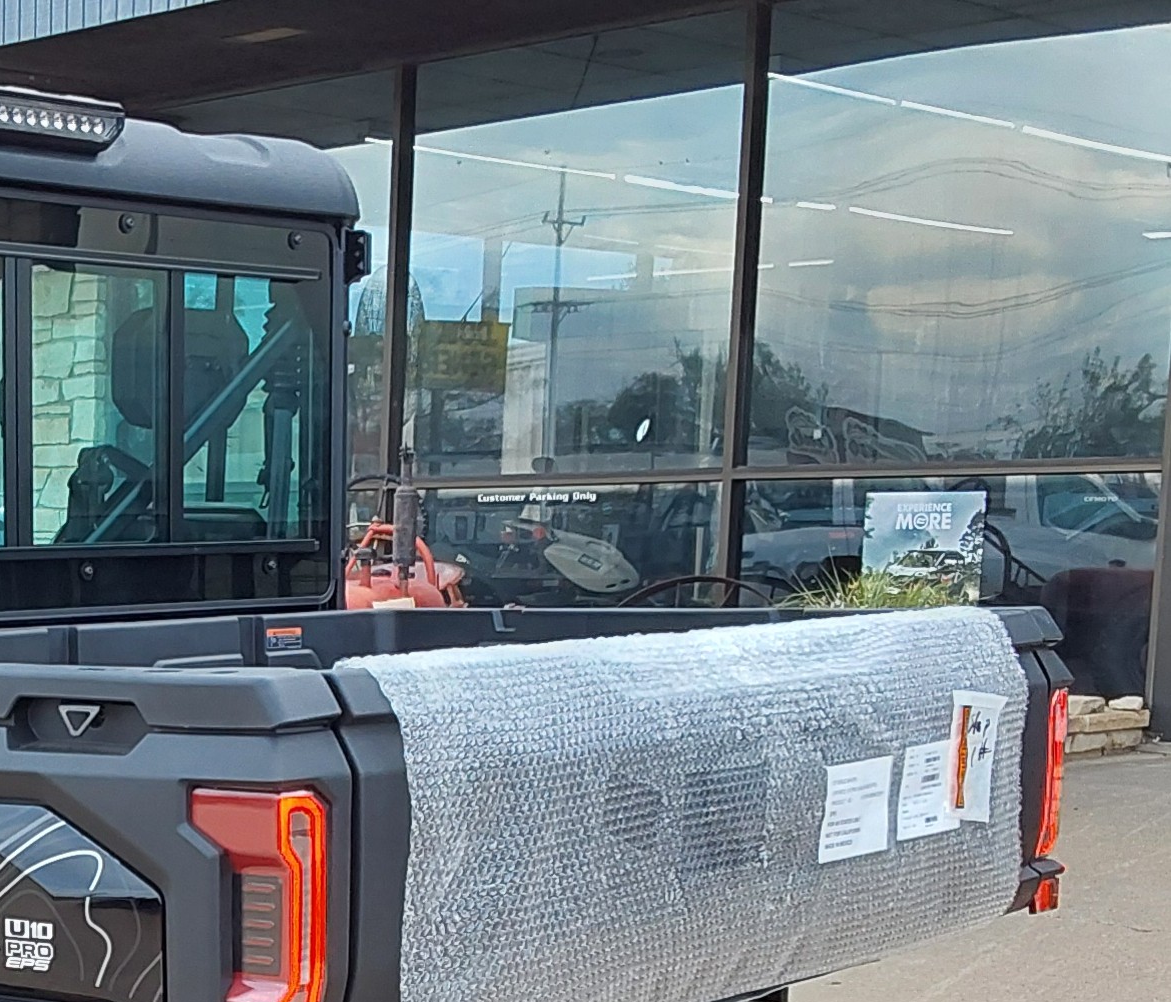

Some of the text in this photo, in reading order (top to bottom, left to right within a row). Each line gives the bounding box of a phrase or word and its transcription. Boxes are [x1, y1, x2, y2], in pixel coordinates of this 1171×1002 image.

[477, 491, 597, 503] Customer Parking Only
[897, 503, 953, 512] EXPERIENCE
[895, 512, 952, 530] MORE
[4, 918, 54, 940] U10
[5, 940, 54, 961] PRO
[5, 957, 52, 972] EPS
